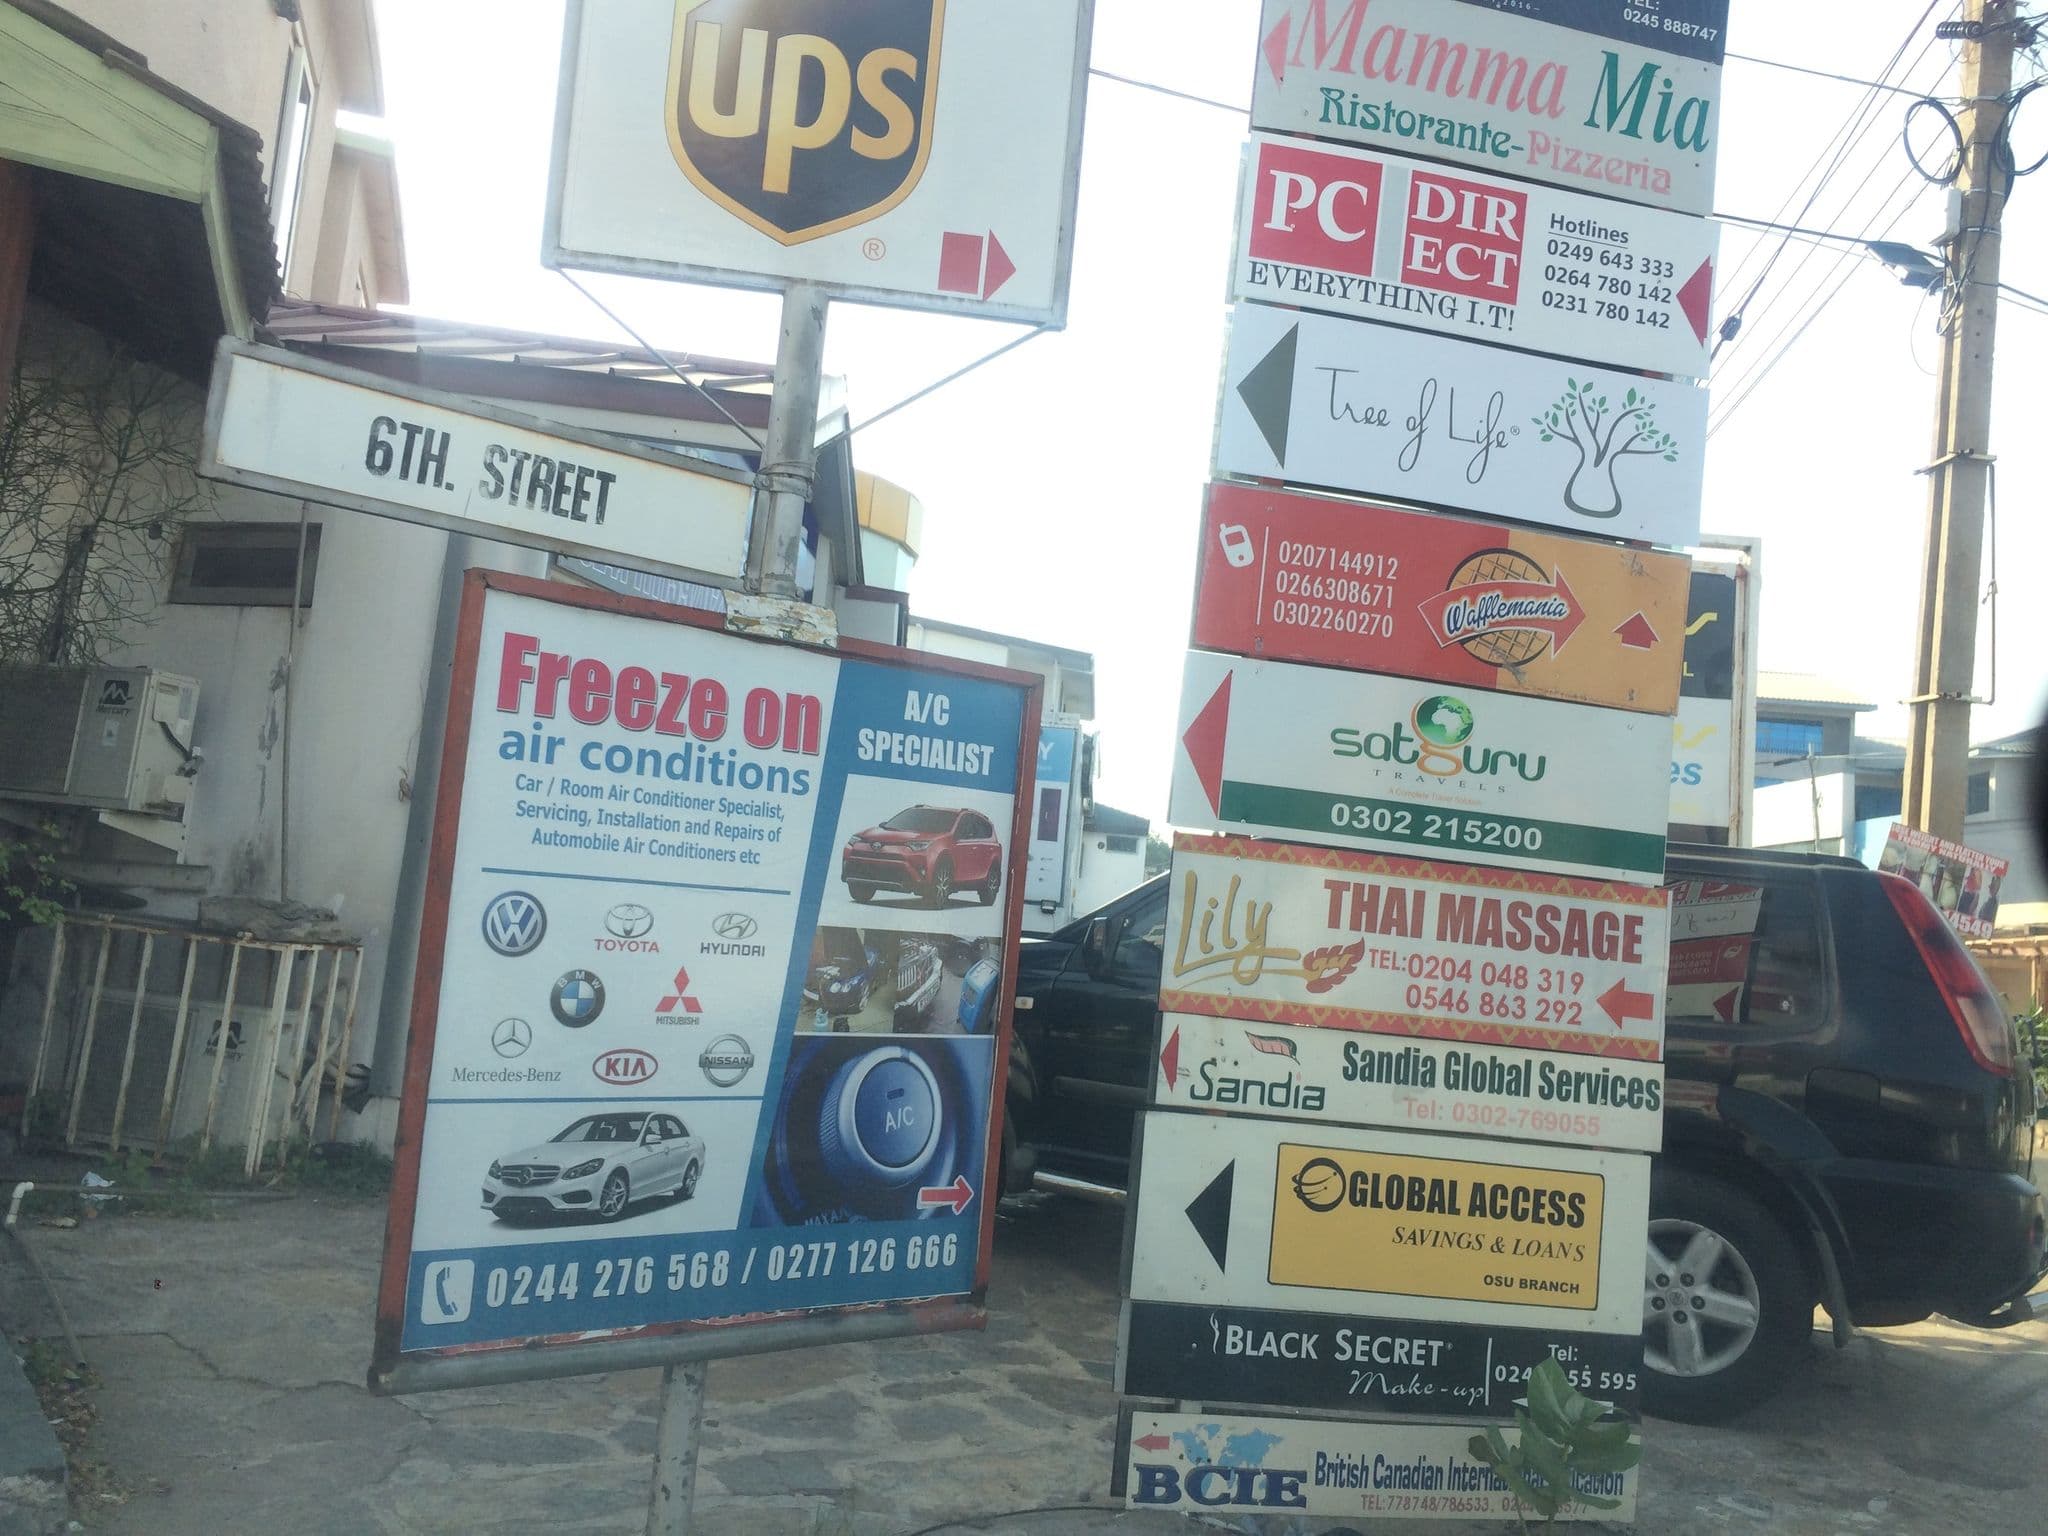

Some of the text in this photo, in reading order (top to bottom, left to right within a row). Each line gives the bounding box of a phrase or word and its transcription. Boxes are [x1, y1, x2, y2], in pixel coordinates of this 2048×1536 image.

[1623, 8, 1718, 41] 0245 888747
[1287, 0, 1710, 153] Mamma Mia
[687, 20, 919, 194] ups
[1263, 169, 1369, 243] PC
[1411, 178, 1520, 243] DIR
[1550, 213, 1629, 244] Hotlines
[1406, 232, 1519, 290] ECT
[1547, 239, 1674, 279] 0249 643 333
[1246, 260, 1458, 319] EVERYTHING
[1544, 264, 1672, 305] 0264 780 142
[1541, 290, 1670, 330] 0231 780 142
[1315, 367, 1391, 427] Tree
[1398, 378, 1437, 472] of
[365, 415, 617, 525] 6TH. STREET
[1278, 541, 1399, 581] 0207144912
[1275, 570, 1395, 609] 0266308671
[1273, 600, 1394, 638] 0302260270
[1445, 596, 1569, 636] Wafflemania
[496, 631, 823, 757] Freeze on
[903, 689, 950, 726] A/C
[499, 723, 811, 797] air conditions
[857, 729, 995, 777] SPECIALIST
[1329, 696, 1546, 782] satguru
[515, 773, 543, 792] Car
[560, 779, 604, 799] Room
[608, 785, 629, 802] Air
[633, 787, 715, 812] Conditioner
[718, 797, 784, 821] Specialist,
[515, 800, 781, 842] Servicing, Installation and Repairs of
[1330, 802, 1542, 852] 0302 215200
[531, 828, 760, 864] Automobile Air Conditioners etc
[1174, 869, 1300, 986] Lily
[1323, 879, 1425, 940] THAI
[1436, 893, 1643, 965] MASSAGE
[594, 938, 660, 953] TOYOTA
[700, 941, 765, 957] HYUNDAI
[1480, 961, 1528, 990] 048
[1537, 968, 1584, 995] 319
[1406, 984, 1582, 1026] 0546 863 292
[451, 1067, 562, 1083] Mercedes-Benz
[704, 1056, 750, 1065] NISSAN
[1342, 1041, 1661, 1112] Sandia Global Services
[1190, 1061, 1326, 1111] Sandia
[884, 1105, 916, 1134] A/C
[1404, 1098, 1601, 1137] Tel: 0302-769055
[1348, 1170, 1585, 1229] GLOBAL ACCESS
[1392, 1226, 1585, 1263] SAVINGS & LOANS
[486, 1262, 580, 1308] 0244
[593, 1257, 655, 1299] 276
[668, 1249, 731, 1291] 568
[767, 1240, 838, 1283] 0277
[847, 1237, 896, 1274] 126
[906, 1232, 958, 1269] 666
[1483, 1274, 1580, 1295] OSU BRANCH
[1224, 1325, 1444, 1367] BLACK SECRET
[1547, 1343, 1578, 1361] Tel:
[1494, 1364, 1536, 1384] 024
[1599, 1372, 1637, 1391] 595
[1132, 1463, 1308, 1509] BCIE
[1315, 1451, 1369, 1489] British
[1373, 1454, 1444, 1490] Canadian
